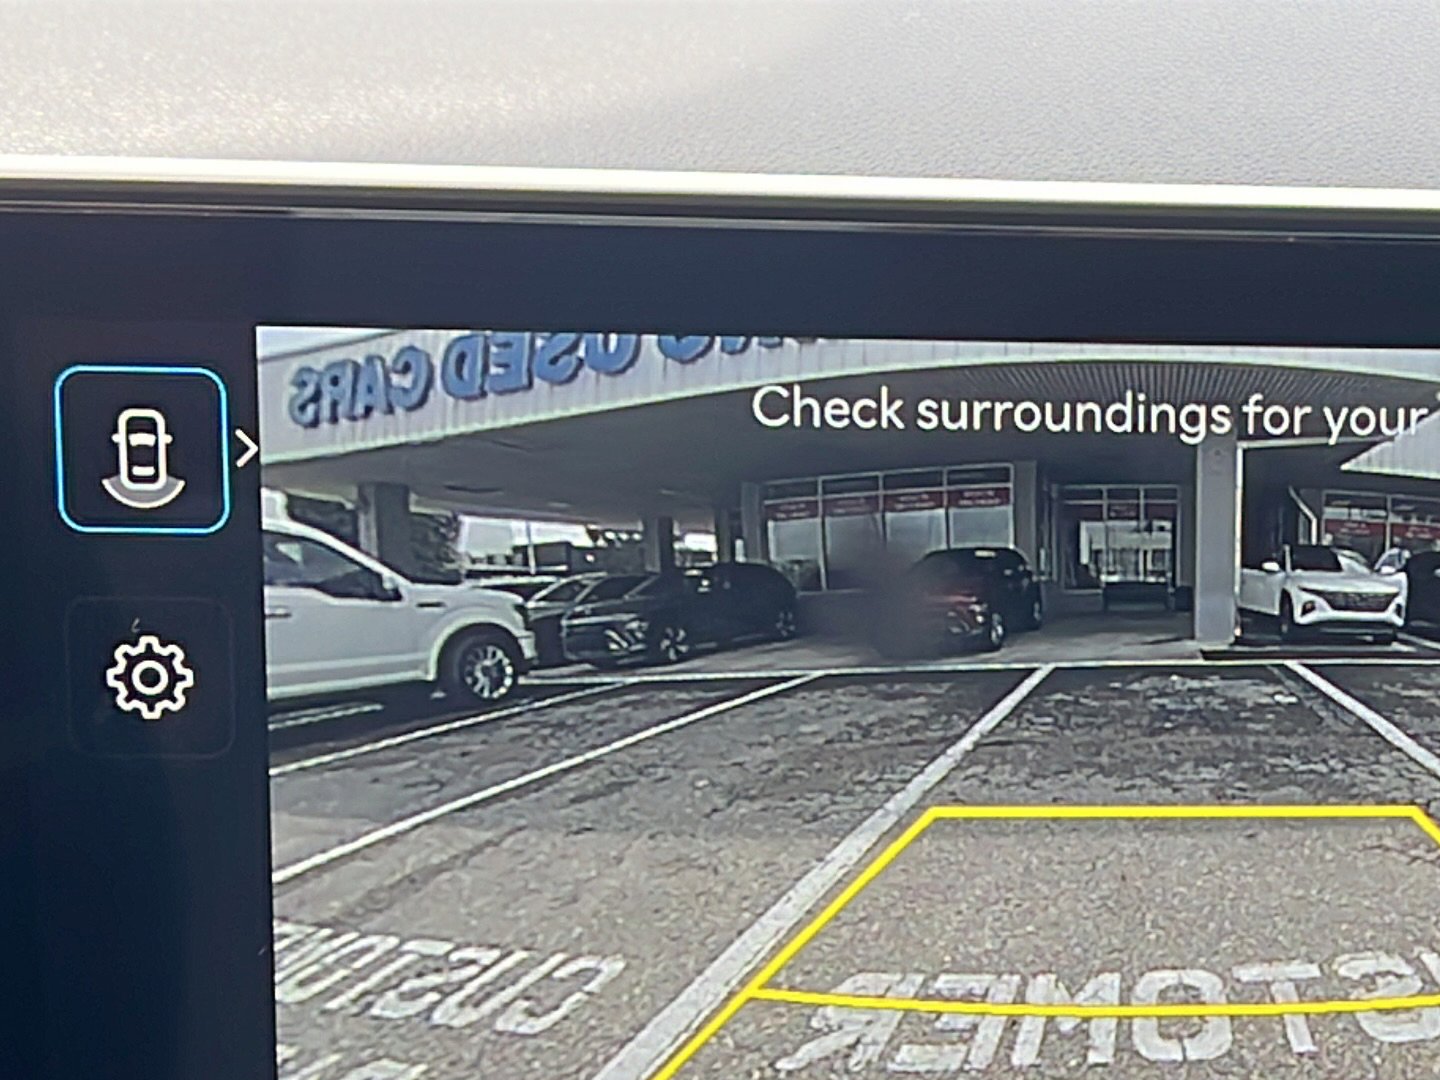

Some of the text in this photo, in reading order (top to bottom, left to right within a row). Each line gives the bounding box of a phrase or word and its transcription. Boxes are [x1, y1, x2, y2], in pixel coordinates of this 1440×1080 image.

[752, 384, 905, 430] Check
[915, 389, 1232, 445] surroundings
[1242, 394, 1312, 436] for
[1323, 404, 1429, 446] your
